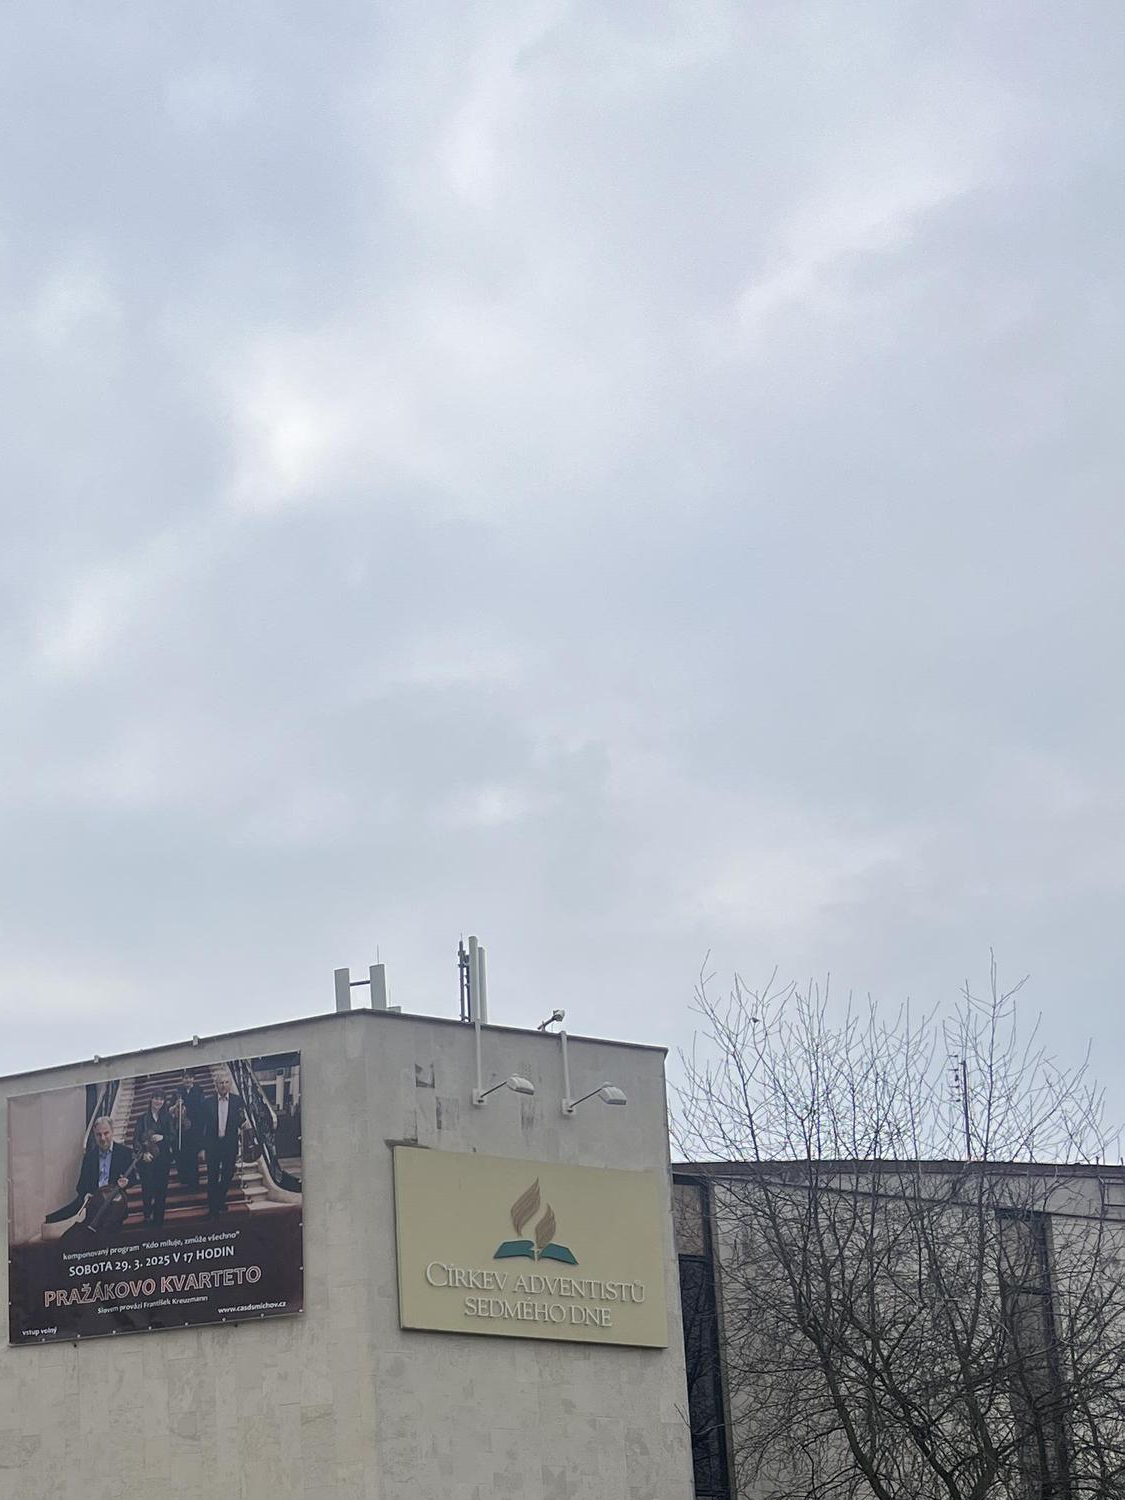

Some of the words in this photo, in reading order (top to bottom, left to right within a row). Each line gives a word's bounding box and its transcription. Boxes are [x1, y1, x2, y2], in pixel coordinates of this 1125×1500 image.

[63, 1248, 109, 1260] komponovaný
[110, 1245, 139, 1255] program
[160, 1237, 183, 1248] miluje,
[68, 1260, 113, 1277] SOBOTA
[115, 1261, 131, 1271] 29.
[134, 1259, 143, 1270] 3.
[146, 1255, 170, 1267] 2025
[173, 1252, 181, 1263] V
[183, 1252, 194, 1264] 17
[196, 1245, 235, 1261] HODIN
[44, 1278, 156, 1308] PRAŽÁKOVO
[160, 1265, 262, 1293] KVARTETO
[513, 1274, 645, 1303] ADVENTISTŮ
[218, 1301, 286, 1313] www.casdsmichov.cz
[464, 1296, 566, 1324] SEDMÉHO
[570, 1303, 613, 1328] DNE
[41, 1326, 57, 1335] volný
